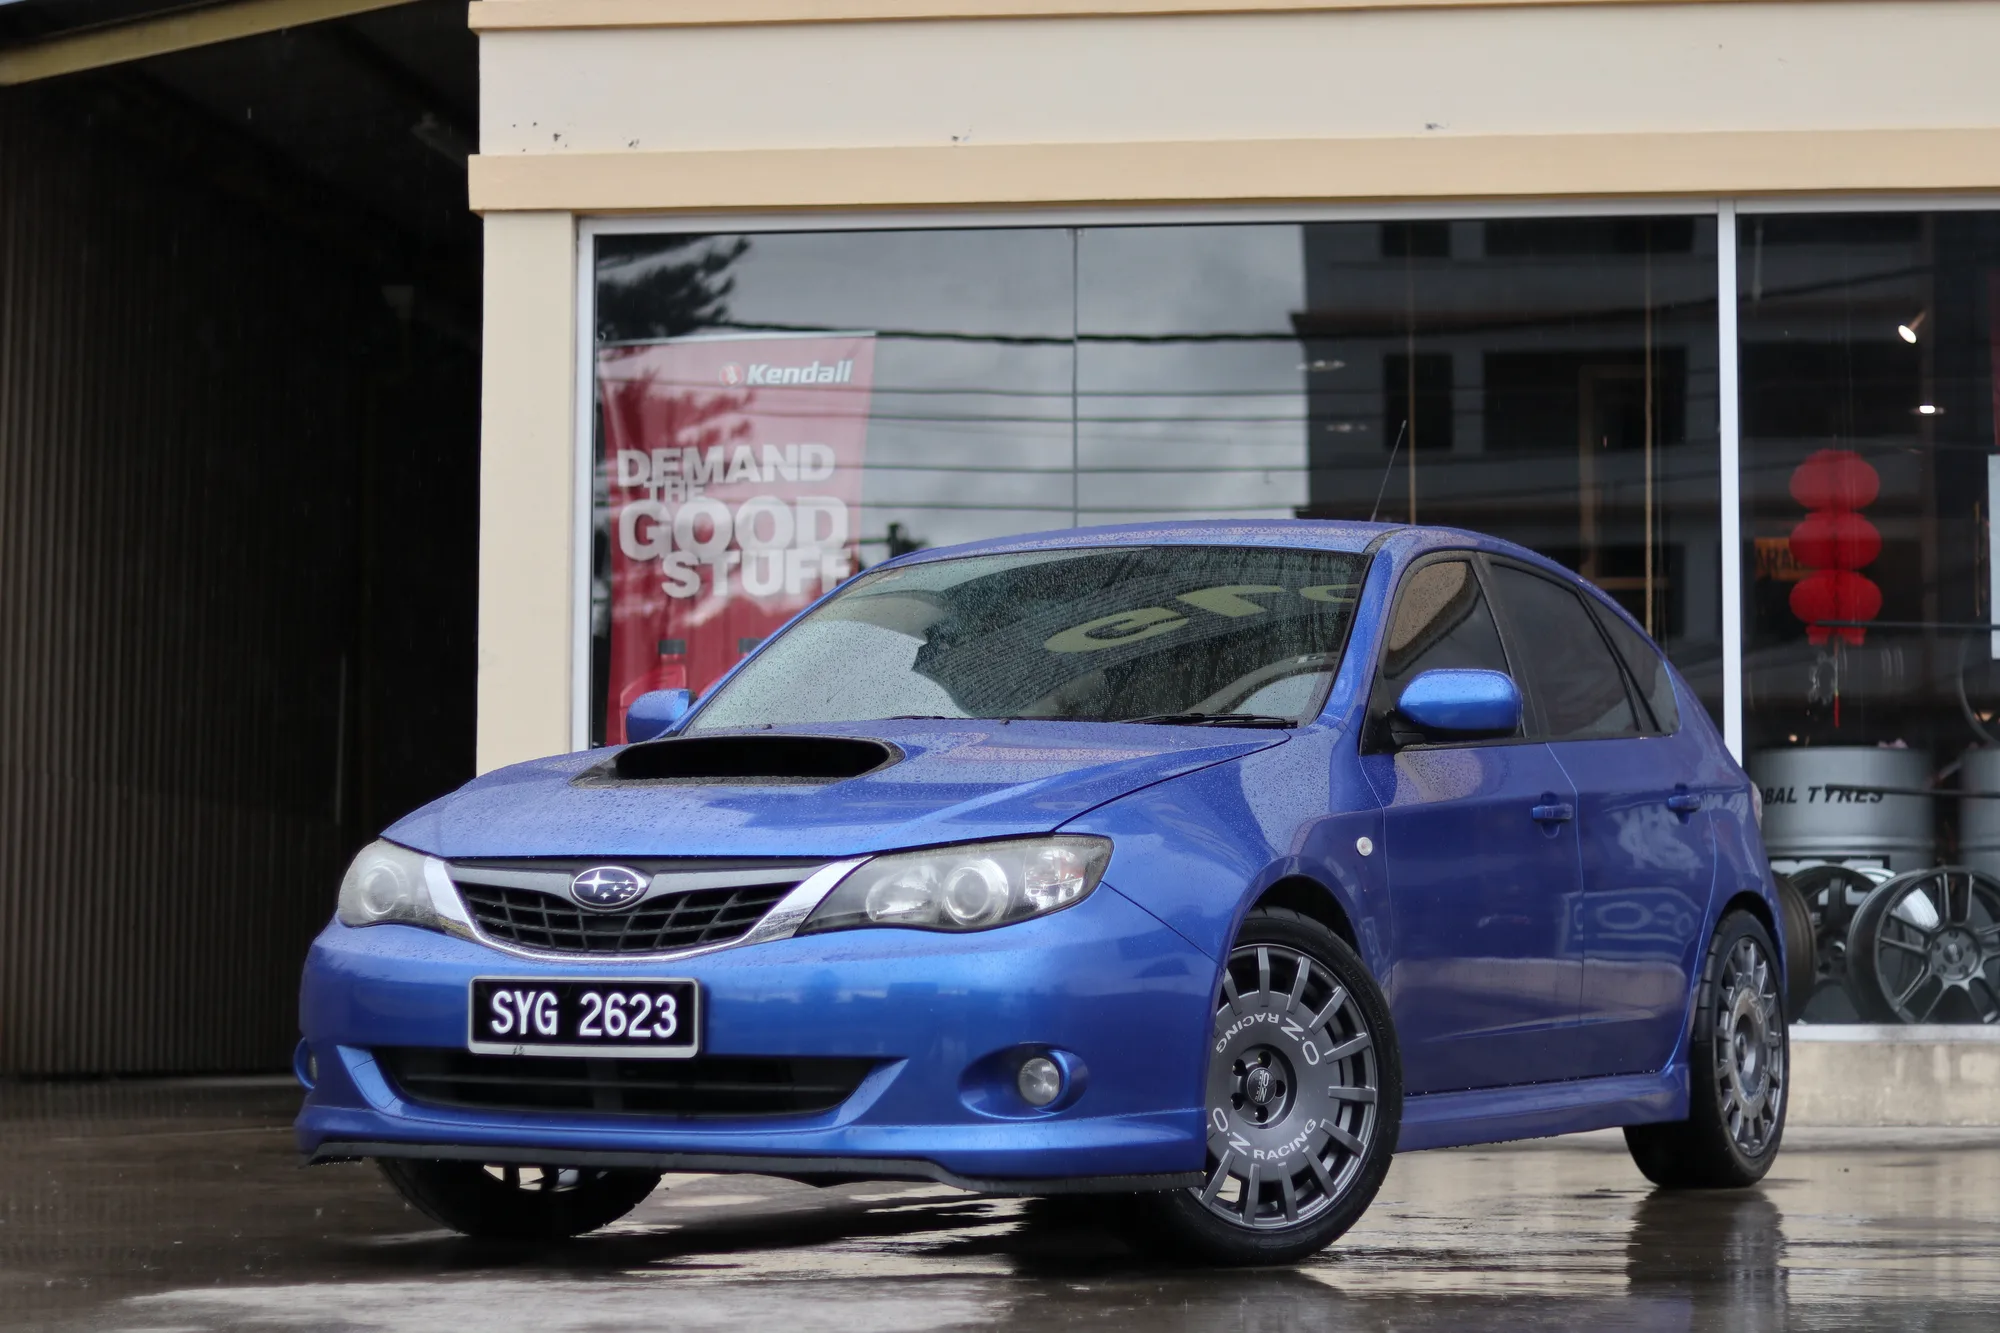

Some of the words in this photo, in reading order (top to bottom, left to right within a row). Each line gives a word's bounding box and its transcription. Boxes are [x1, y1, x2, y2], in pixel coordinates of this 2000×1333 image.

[746, 360, 853, 385] Kendall
[616, 443, 836, 488] DEMAND
[644, 479, 705, 503] THE
[618, 495, 849, 561] GOOD
[661, 546, 851, 598] STUFF
[1760, 785, 1798, 805] BAL
[1807, 784, 1885, 804] TYRES
[491, 990, 558, 1036] SYG
[579, 992, 677, 1038] 2623
[1215, 1012, 1279, 1053] RACING
[1253, 1118, 1317, 1160] RACING
